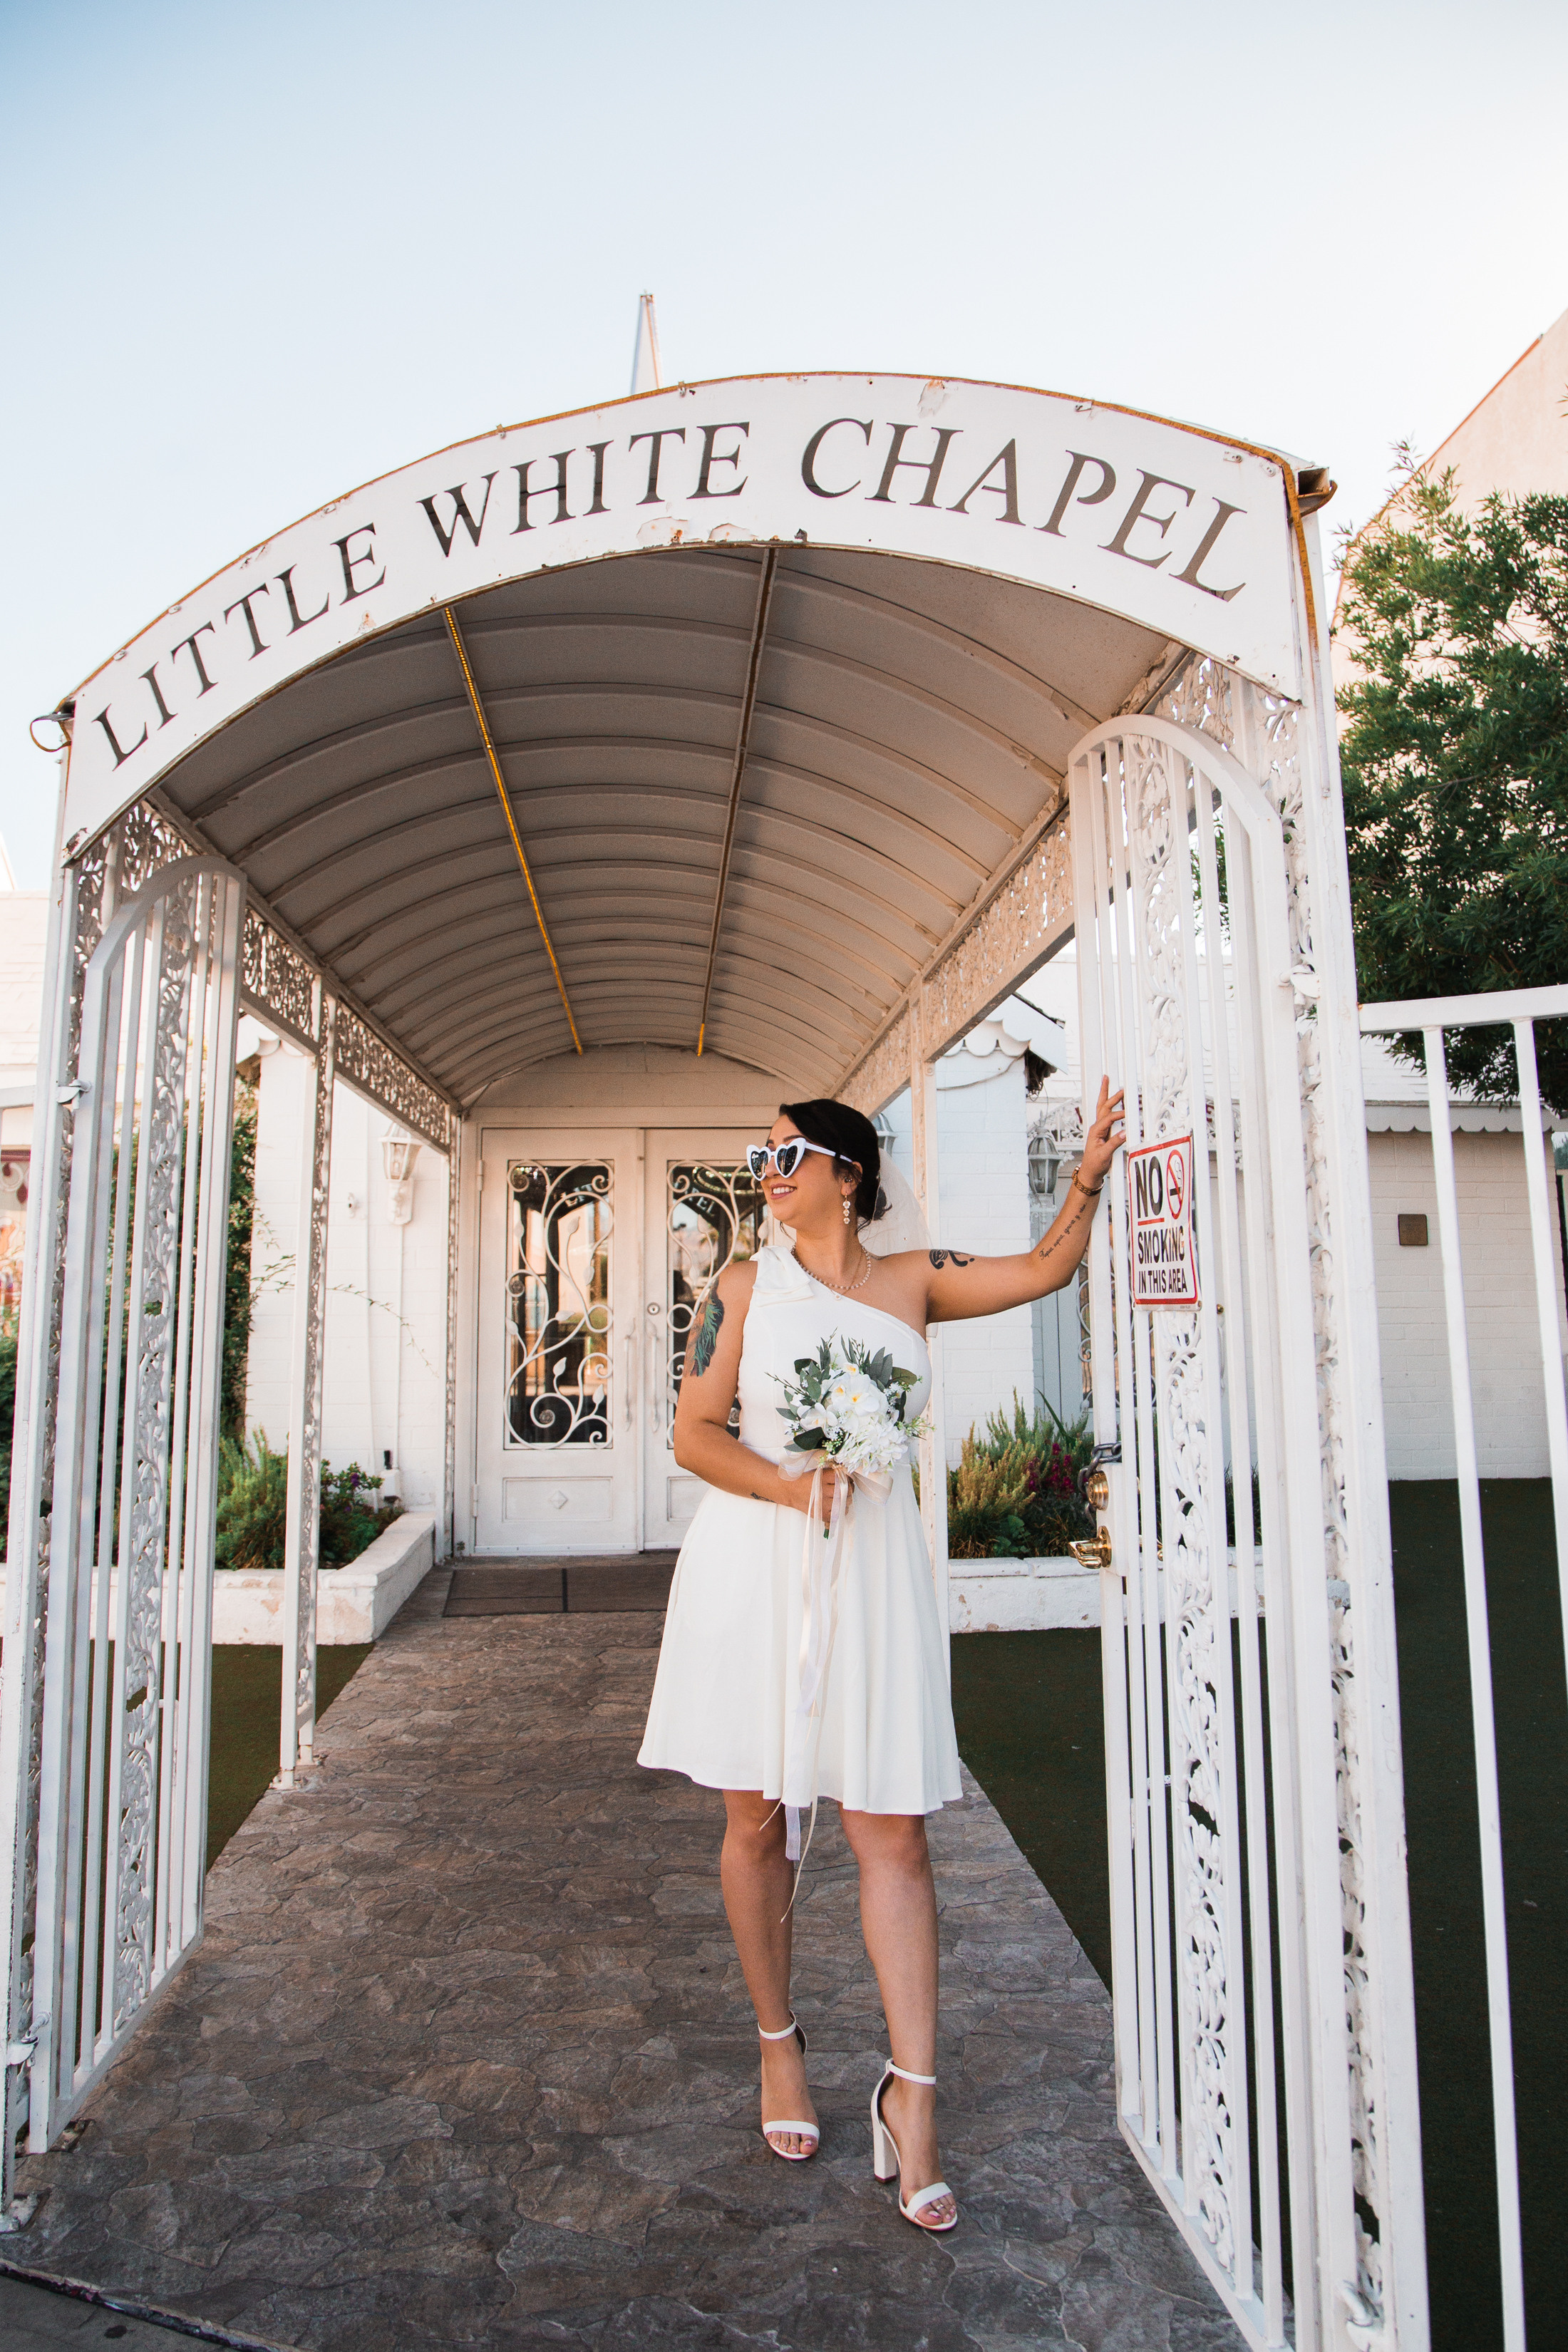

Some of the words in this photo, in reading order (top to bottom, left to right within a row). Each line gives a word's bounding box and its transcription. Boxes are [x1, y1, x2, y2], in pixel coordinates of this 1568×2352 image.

[91, 522, 386, 772] LITTLE
[416, 421, 750, 558] WHITE
[801, 417, 1248, 603] CHAPEL
[1135, 1155, 1163, 1218] NO
[1138, 1225, 1185, 1264] SMOKING
[1138, 1270, 1147, 1294] IN
[1147, 1269, 1167, 1294] THIS
[1168, 1267, 1188, 1294] AREA
